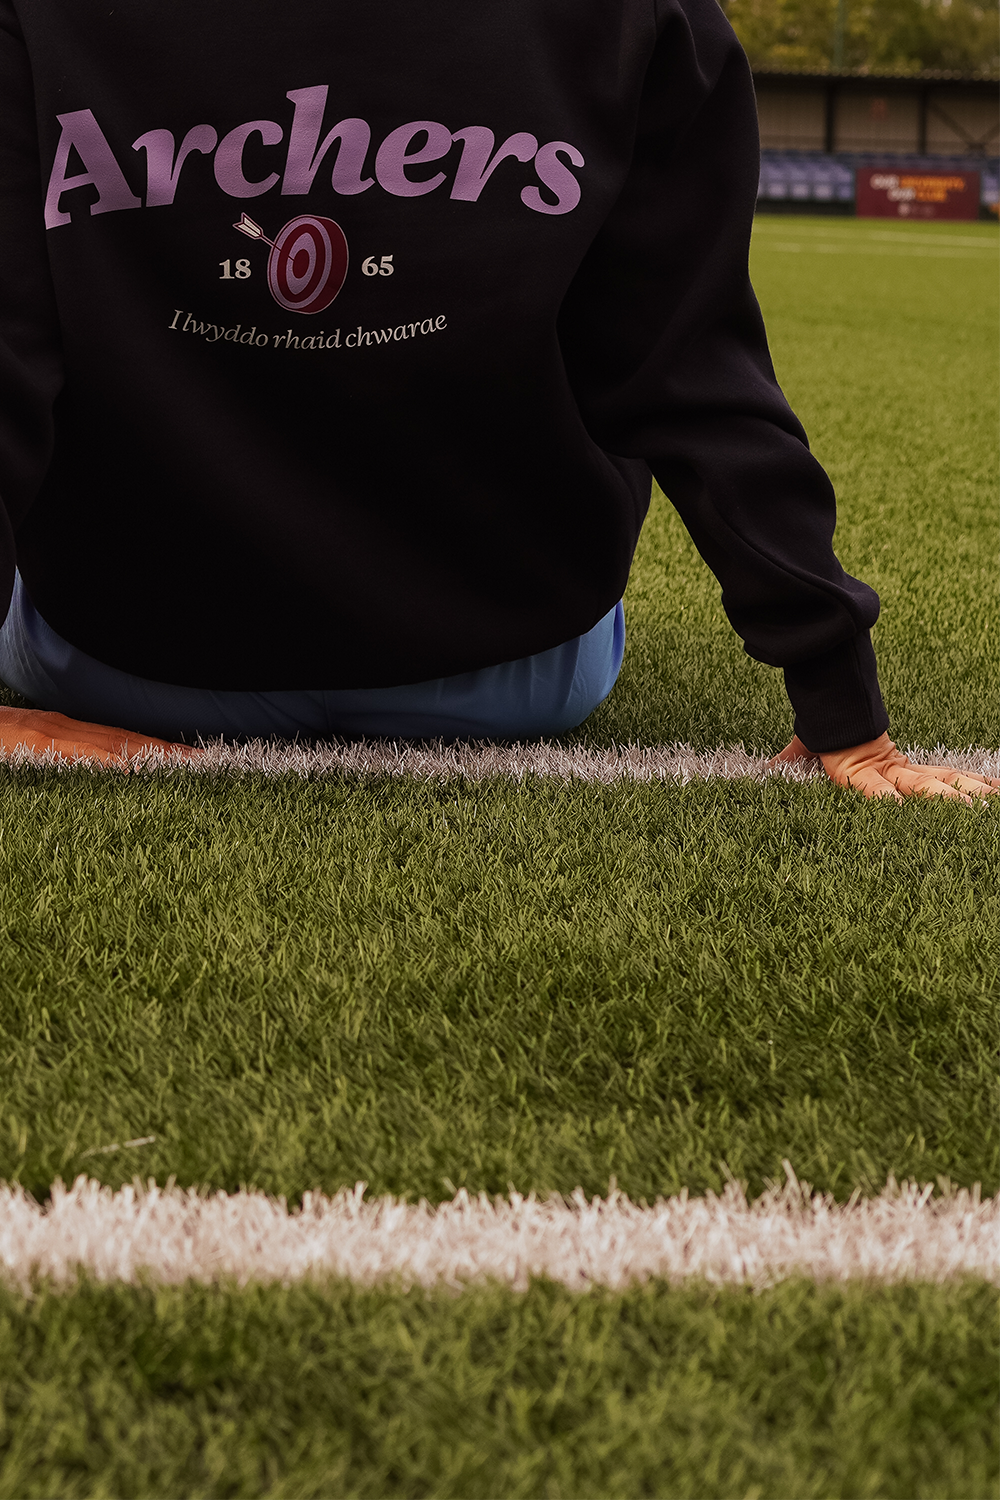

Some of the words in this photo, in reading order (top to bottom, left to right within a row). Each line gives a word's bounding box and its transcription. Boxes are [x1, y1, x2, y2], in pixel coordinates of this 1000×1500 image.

[44, 85, 585, 230] Archers
[218, 258, 252, 280] 18
[361, 254, 395, 277] 65
[272, 328, 343, 350] rhaid
[345, 313, 448, 348] chwarae
